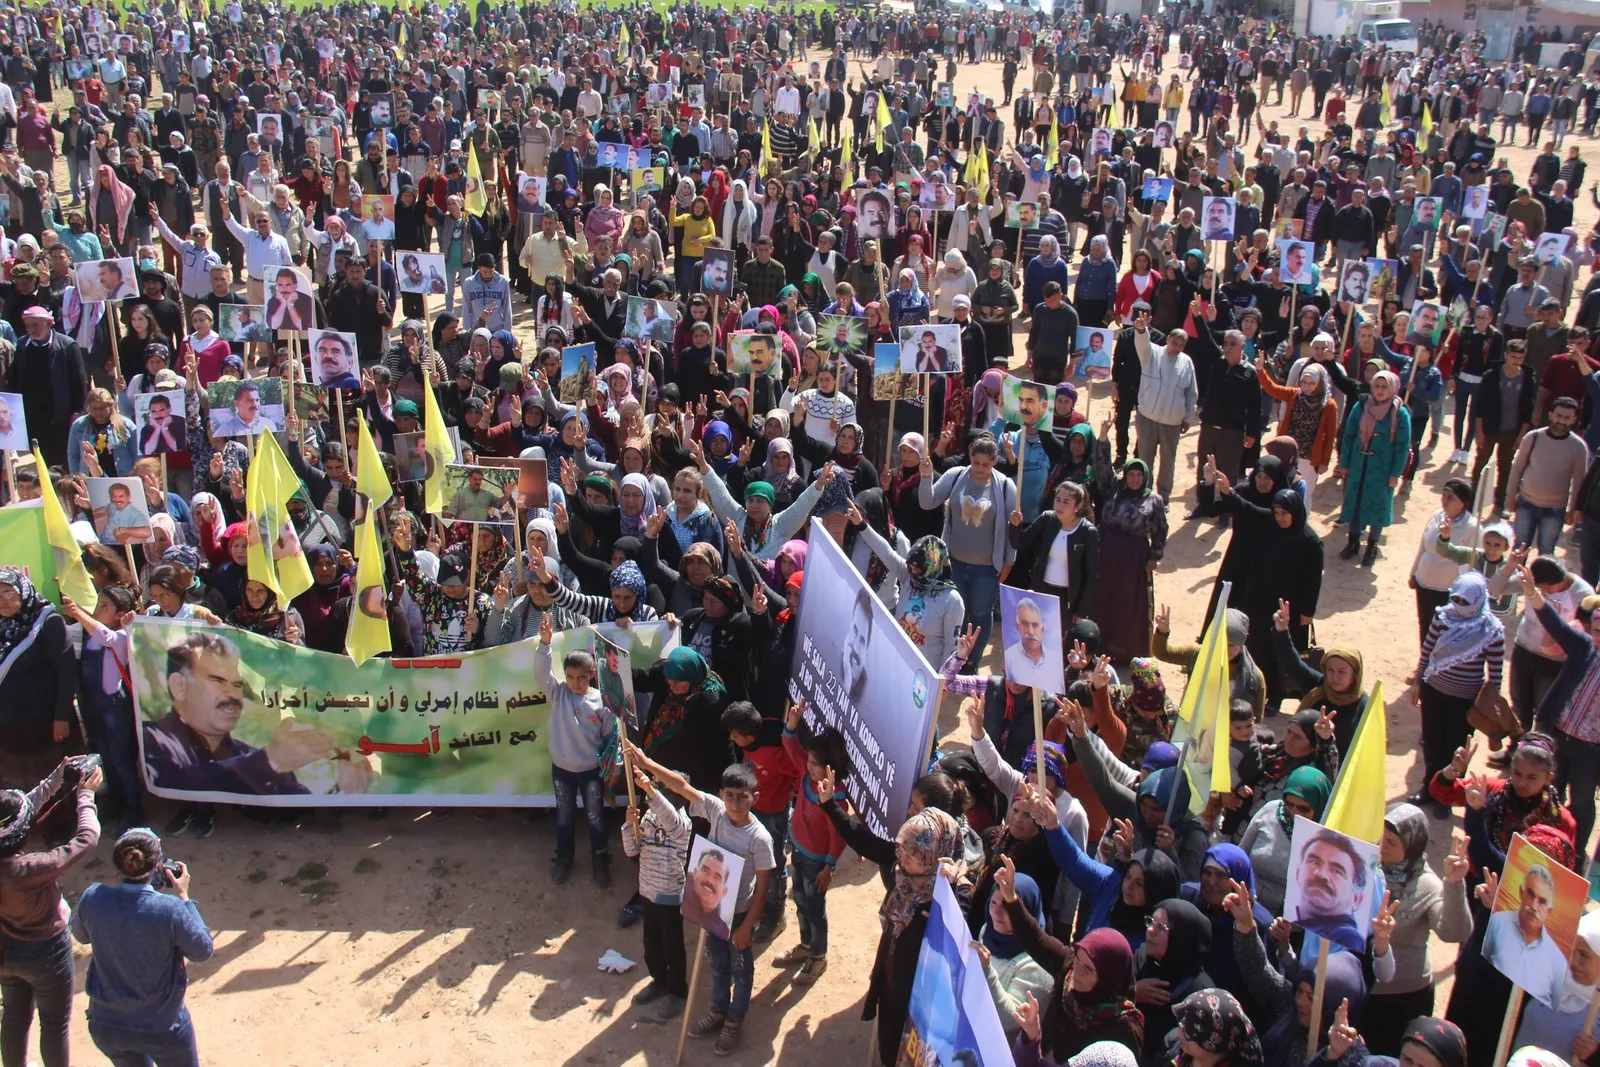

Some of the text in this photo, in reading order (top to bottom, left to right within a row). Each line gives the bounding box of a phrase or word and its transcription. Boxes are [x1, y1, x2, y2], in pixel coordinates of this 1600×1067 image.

[261, 685, 308, 710] أحرارا
[315, 690, 370, 713] نعيش
[376, 685, 395, 713] أن
[415, 690, 458, 717] إمرلي
[463, 691, 499, 715] نظام
[505, 691, 547, 715] نحطم
[812, 648, 826, 680] SALA
[826, 670, 837, 696] 22
[837, 684, 850, 716] YAN
[850, 705, 859, 732] YA
[859, 720, 885, 771] KOMPLO
[886, 761, 896, 788] YÊ
[356, 724, 538, 759] مع القائد آبو
[789, 678, 805, 705] GELA
[859, 790, 867, 815] Û
[803, 668, 813, 692] BO
[879, 788, 889, 818] YA
